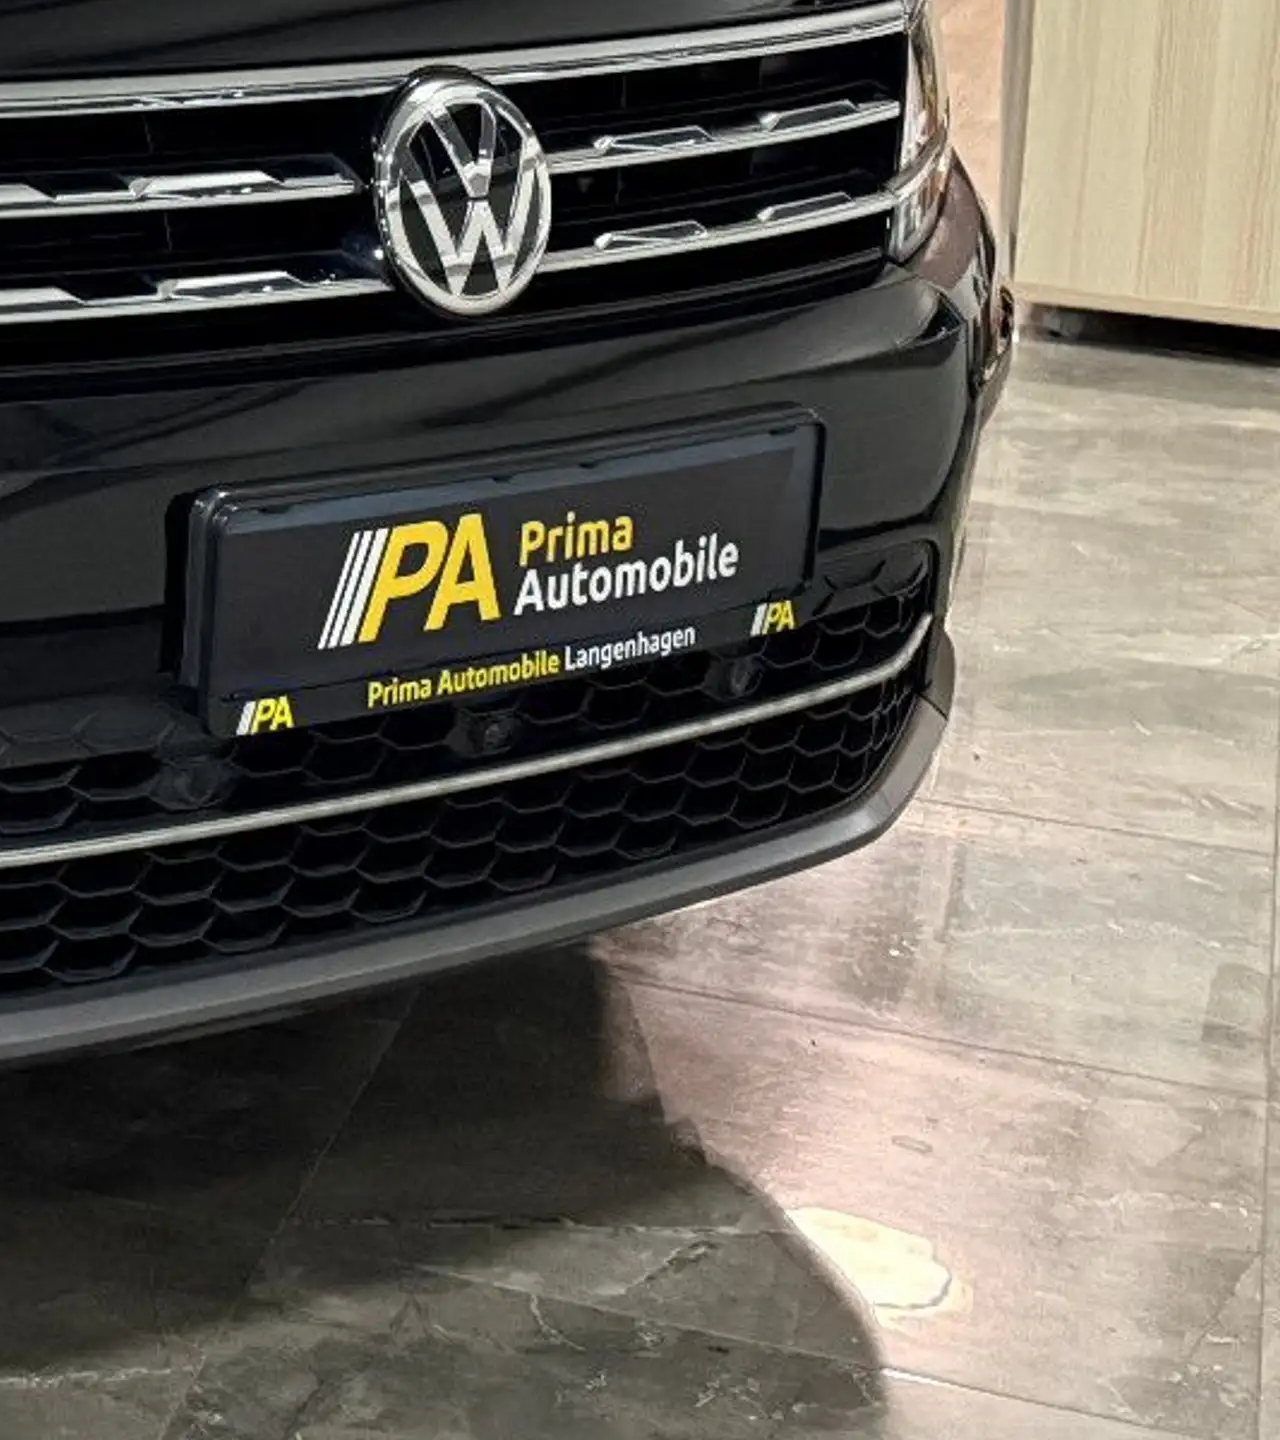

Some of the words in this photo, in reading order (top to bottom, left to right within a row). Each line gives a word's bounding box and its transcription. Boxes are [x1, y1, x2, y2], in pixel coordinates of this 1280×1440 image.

[388, 85, 548, 308] VW
[512, 532, 740, 616] Automobile
[519, 511, 634, 568] Prima
[367, 676, 432, 709] Prima
[436, 650, 562, 696] Automobile
[564, 626, 696, 672] Langenhagen
